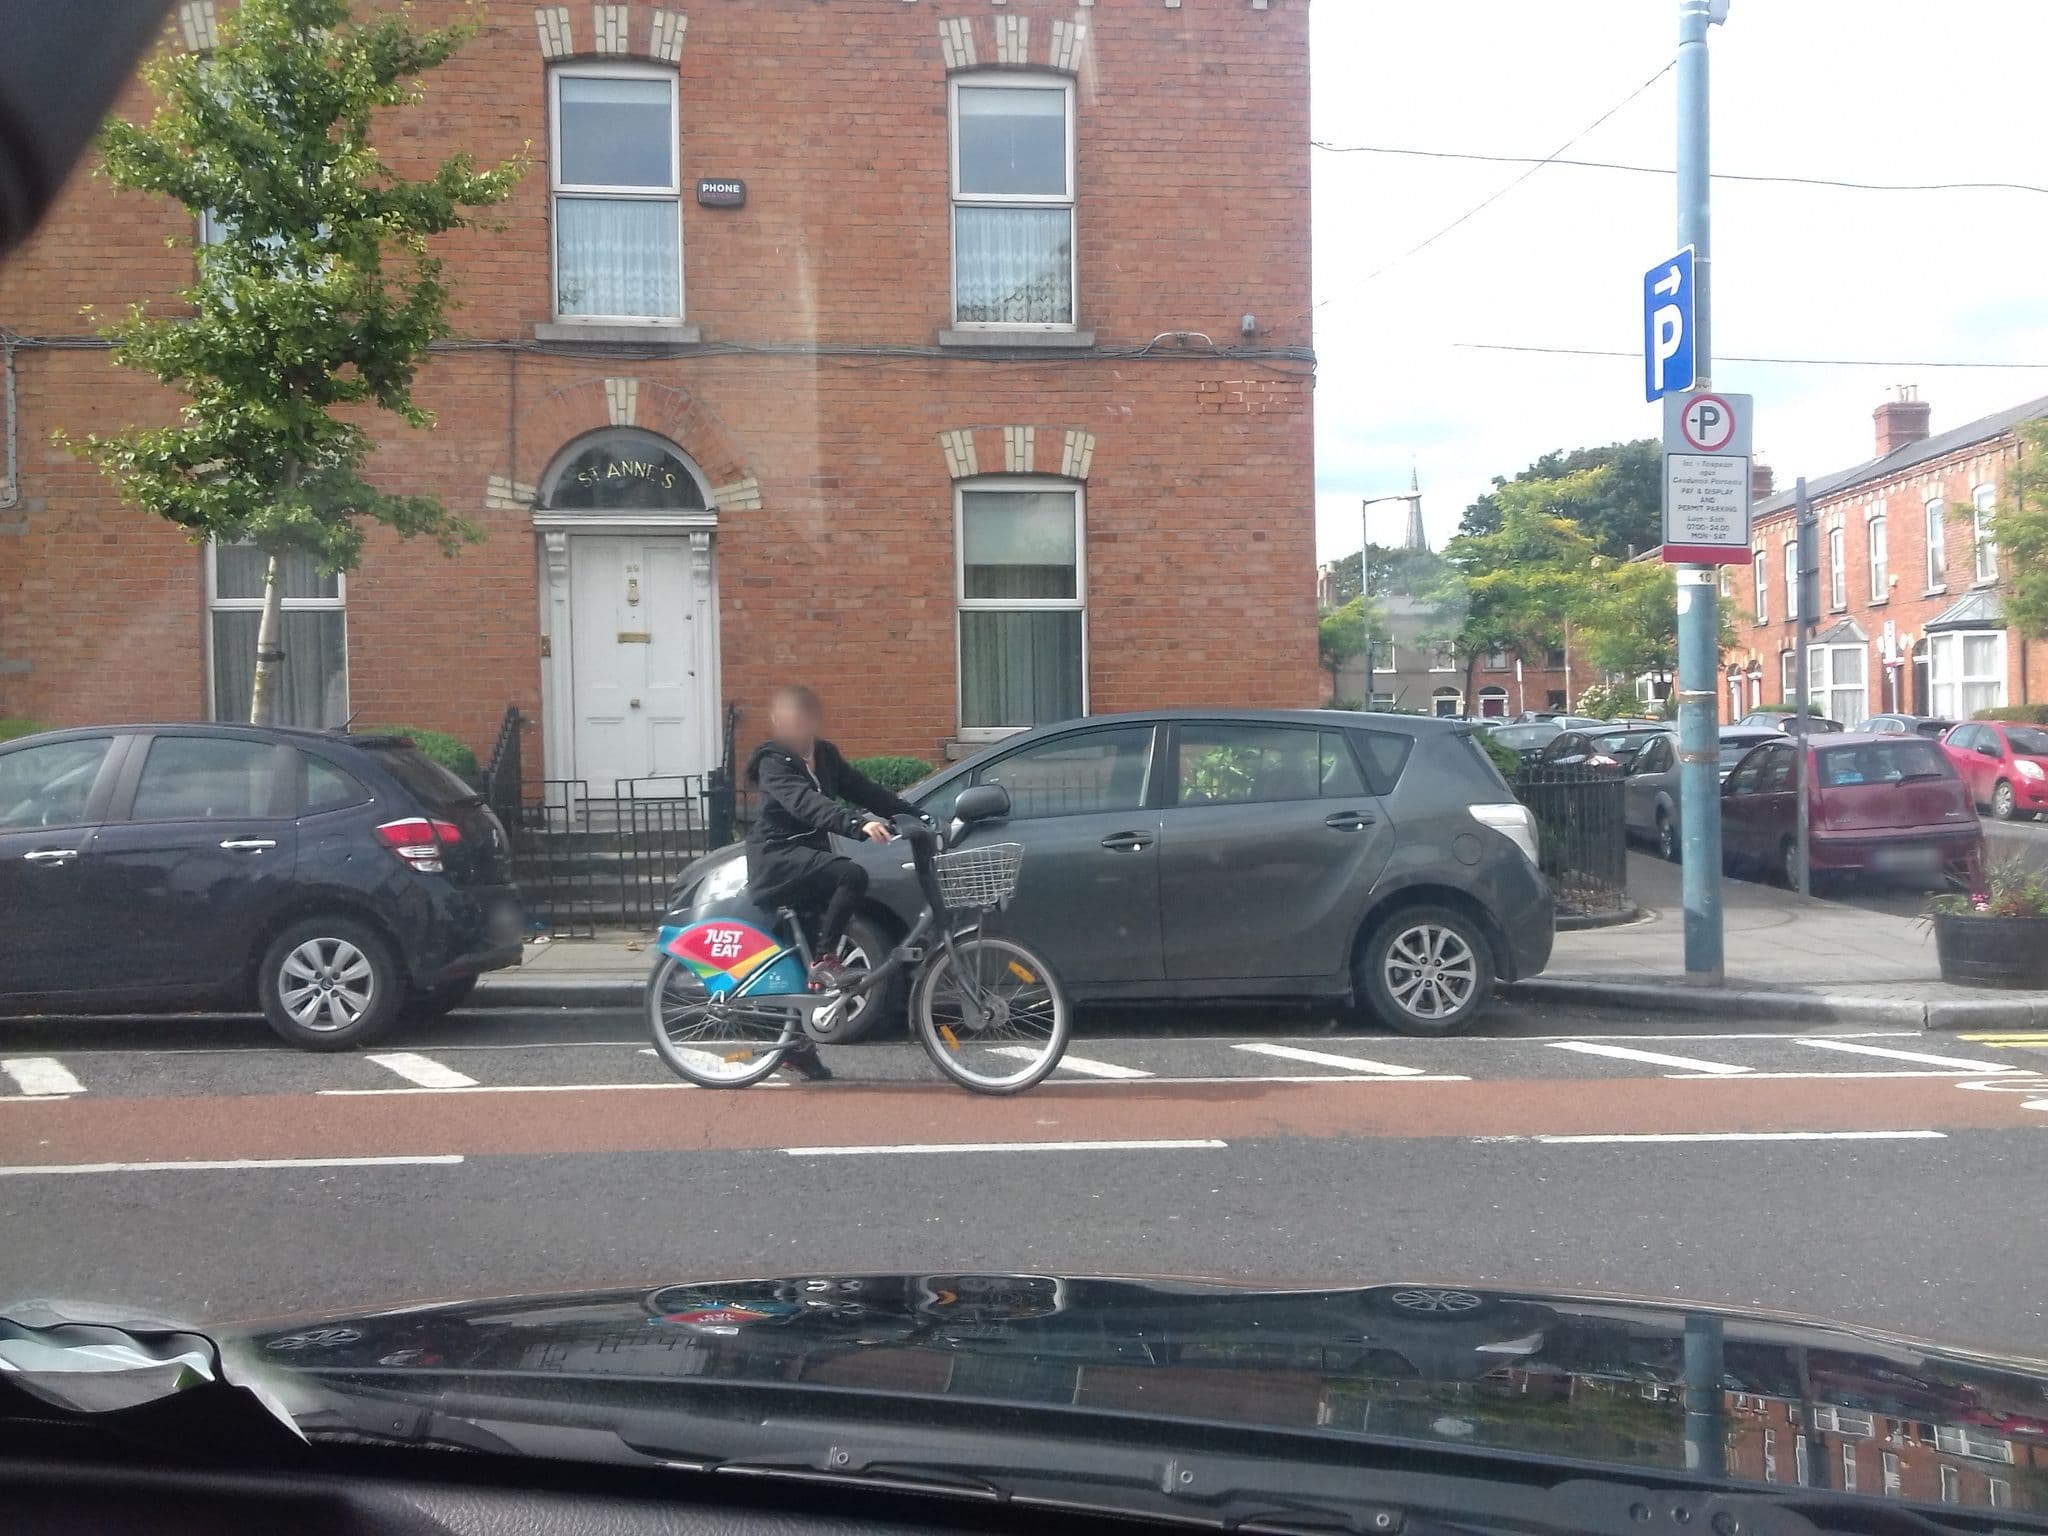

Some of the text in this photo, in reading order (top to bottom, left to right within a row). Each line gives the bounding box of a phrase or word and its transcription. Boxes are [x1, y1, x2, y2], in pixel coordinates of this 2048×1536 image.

[702, 183, 741, 193] PHONE
[1653, 304, 1684, 391] P
[1699, 405, 1720, 440] P
[704, 928, 744, 945] JUST
[710, 943, 743, 958] EAT
